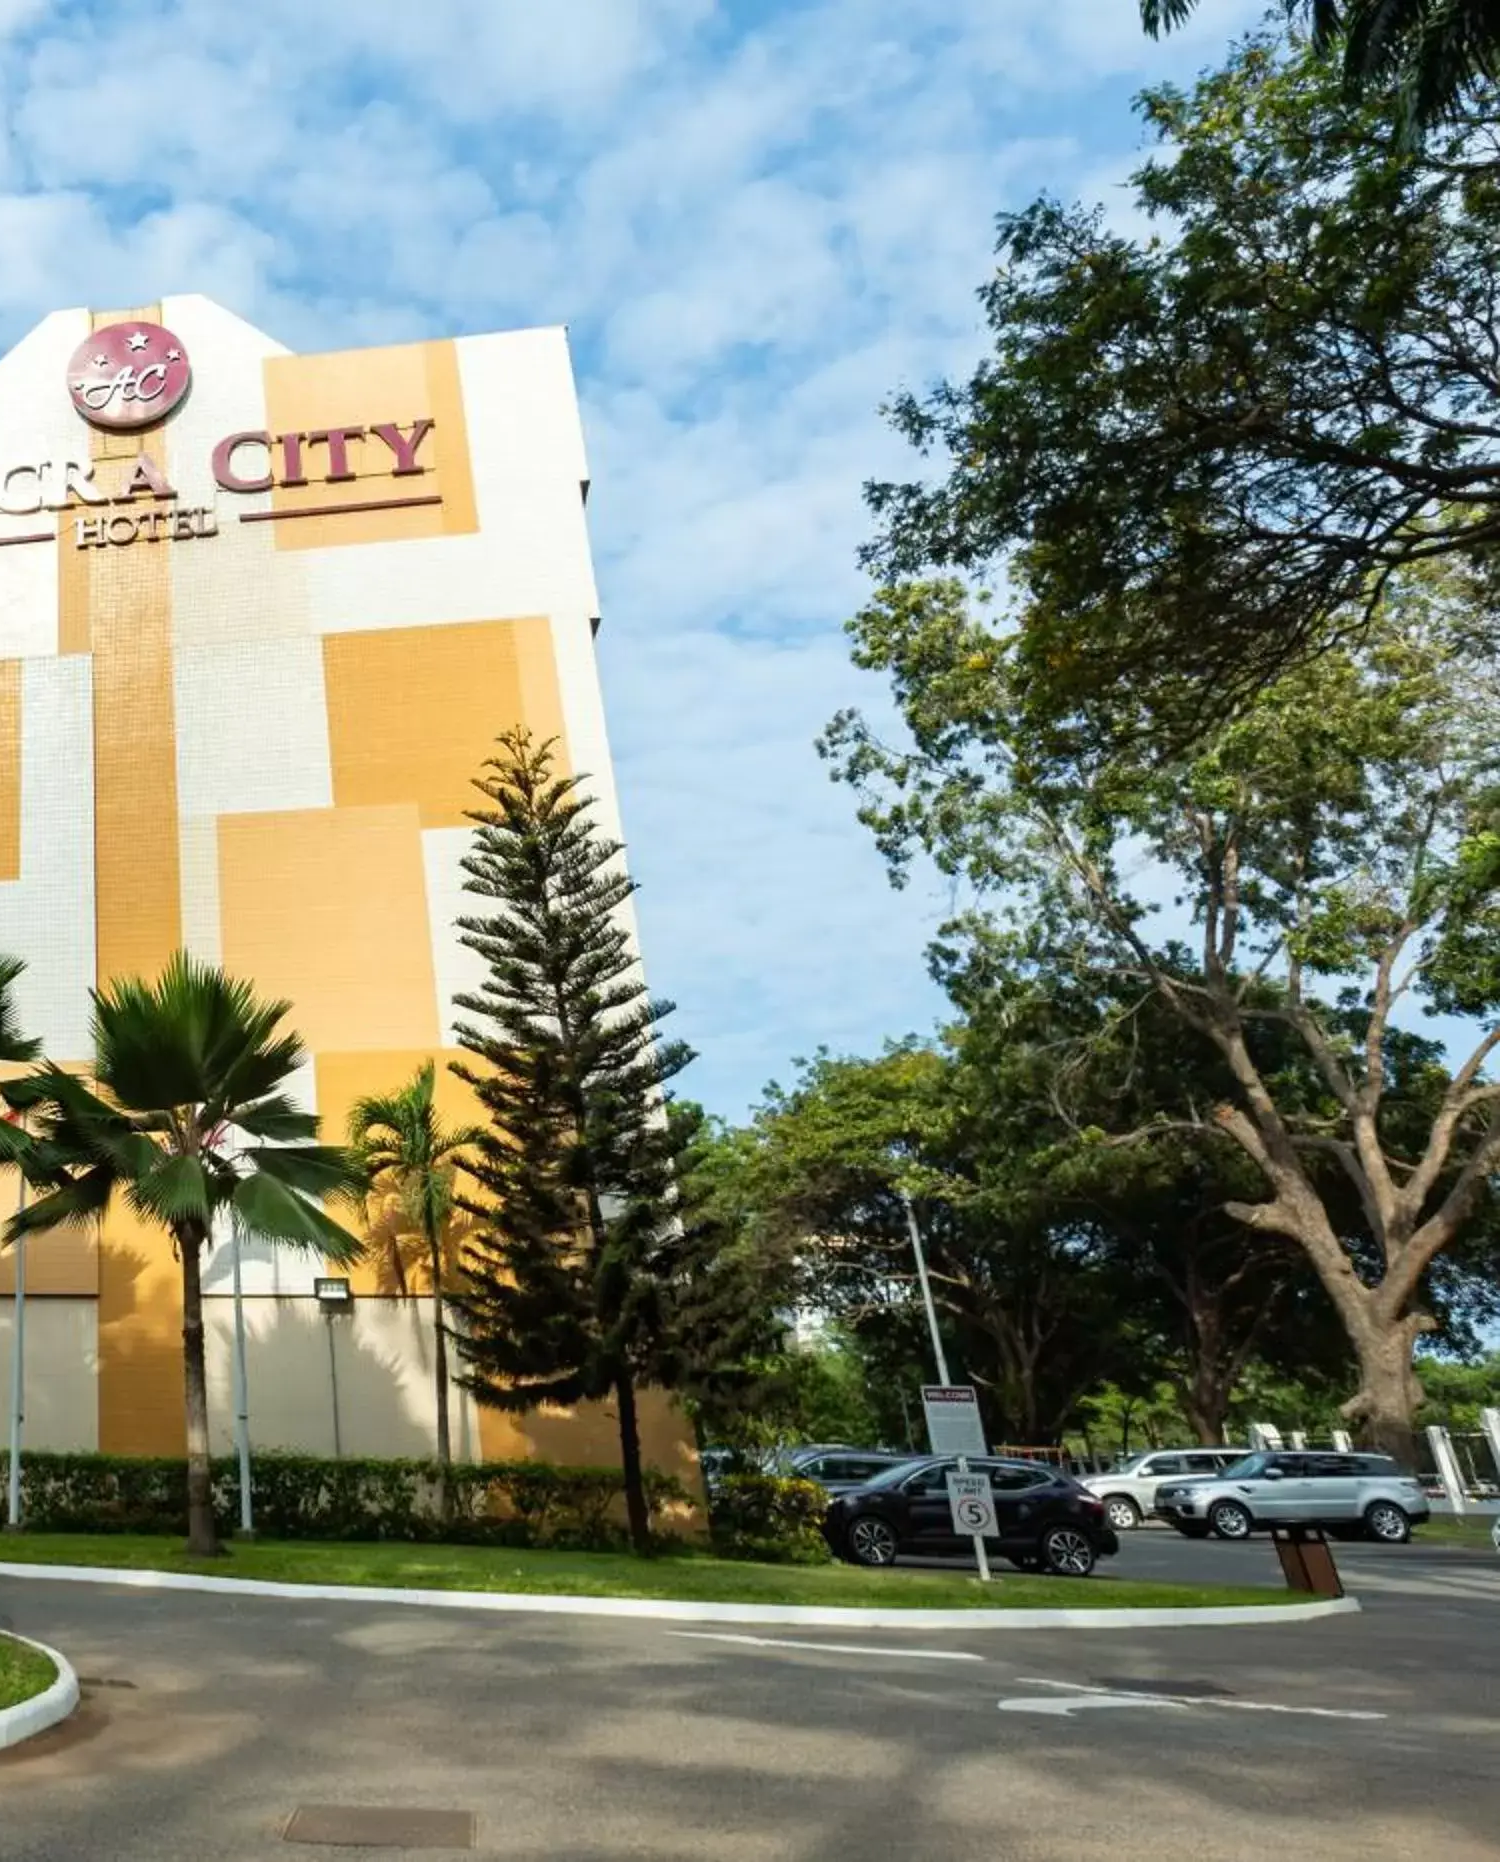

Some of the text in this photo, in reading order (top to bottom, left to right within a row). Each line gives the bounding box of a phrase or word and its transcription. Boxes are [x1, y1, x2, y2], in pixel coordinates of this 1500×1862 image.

[82, 363, 168, 410] AC
[211, 418, 436, 494] CITY
[75, 506, 219, 550] HOTEL
[968, 1503, 982, 1525] 5
